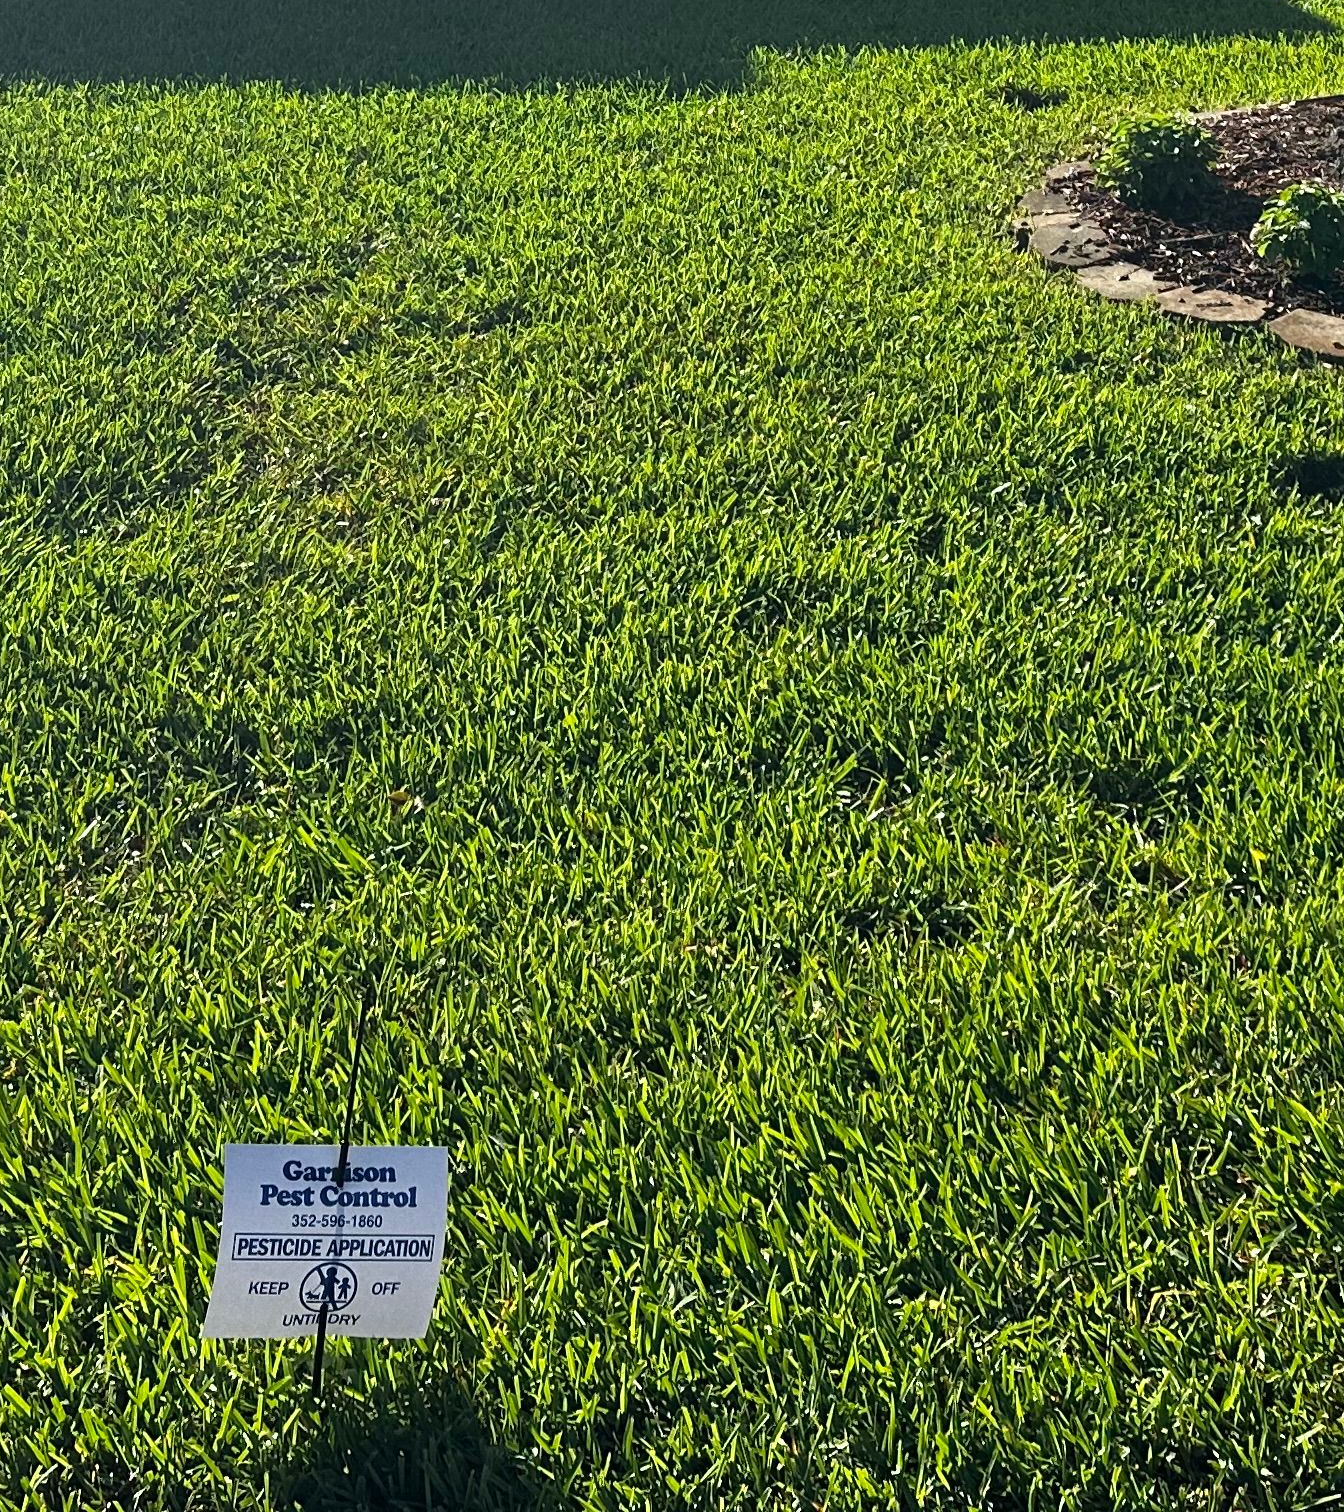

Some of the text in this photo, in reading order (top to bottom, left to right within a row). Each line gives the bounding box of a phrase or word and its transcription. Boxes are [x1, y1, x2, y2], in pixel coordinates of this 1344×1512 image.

[260, 1184, 418, 1208] Pest Control
[291, 1214, 384, 1228] 352-596-1860
[237, 1238, 432, 1257] PESTICIDE APPLICATION
[248, 1281, 401, 1296] KEEP OFF
[328, 1314, 362, 1326] DRY
